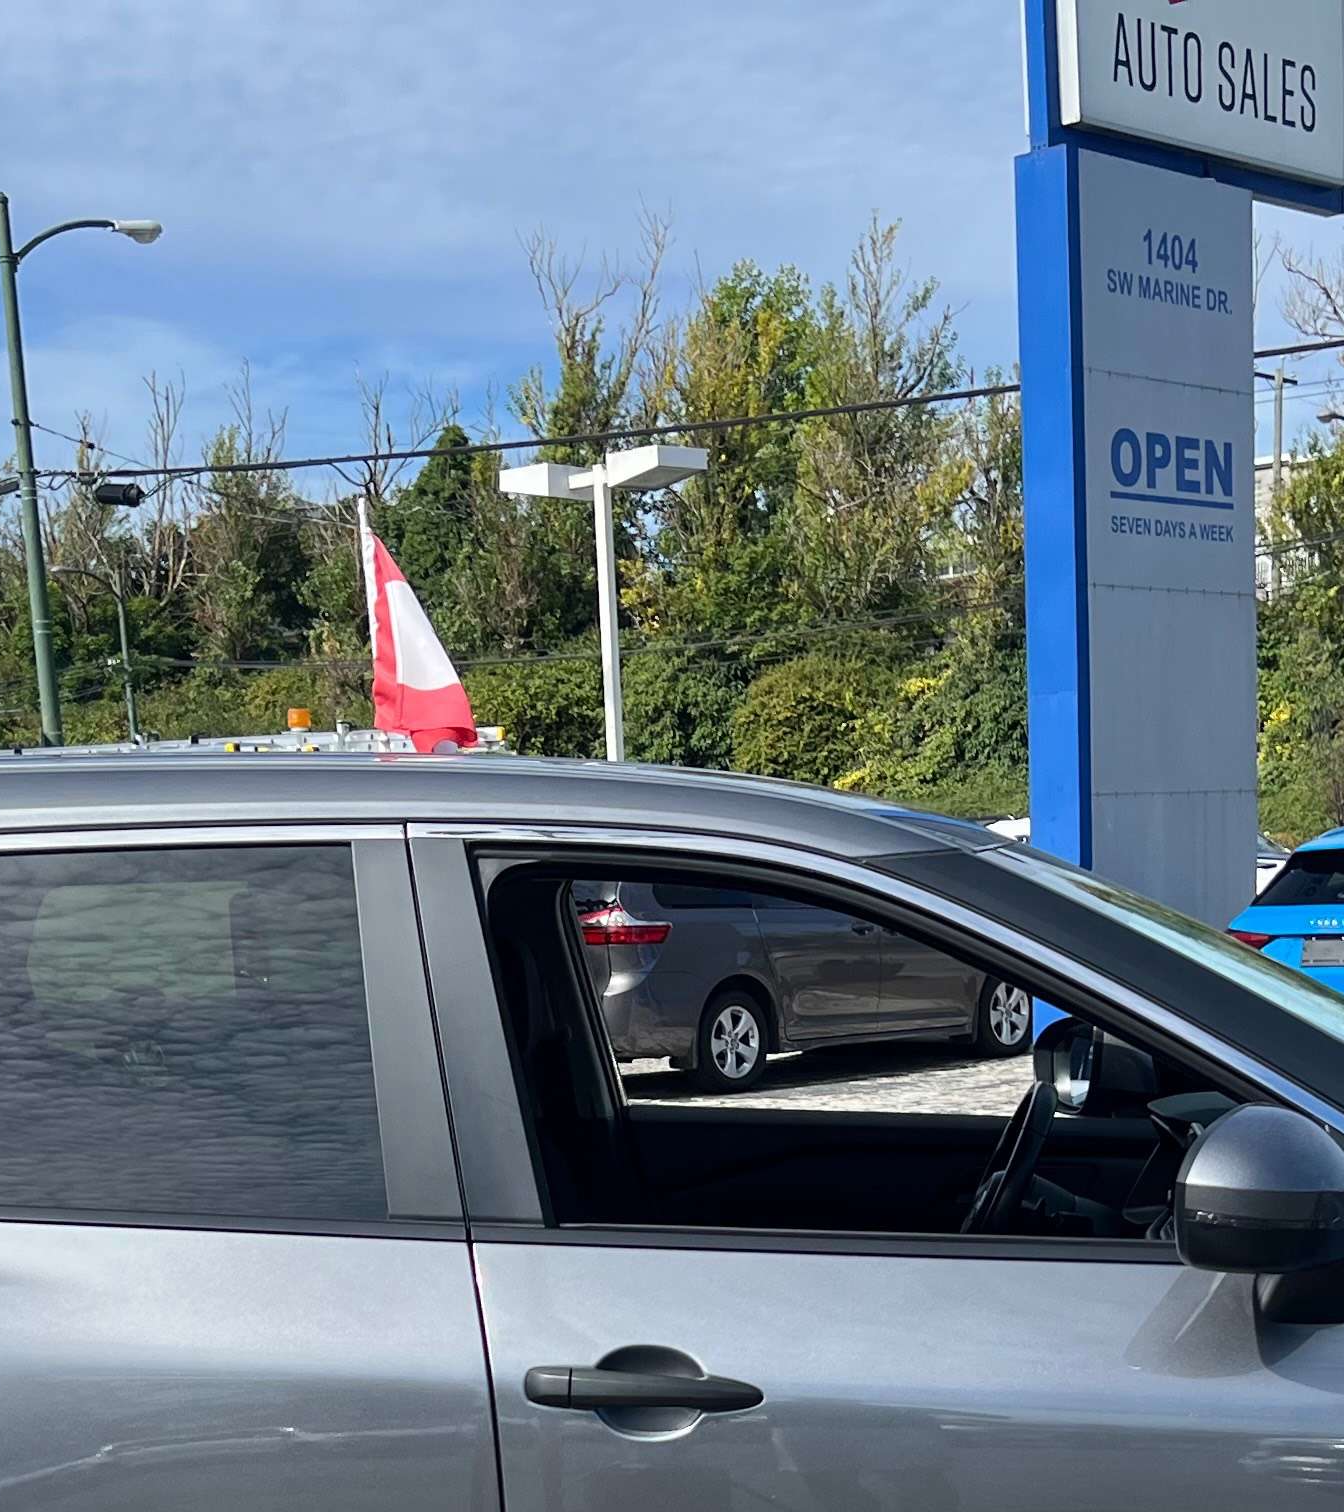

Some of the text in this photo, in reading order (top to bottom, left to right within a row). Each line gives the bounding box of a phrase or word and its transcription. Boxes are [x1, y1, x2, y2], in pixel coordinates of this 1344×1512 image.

[1113, 13, 1316, 132] AUTO SALES
[1143, 228, 1198, 274] 1404
[1107, 268, 1233, 315] SW MARINE DR.
[1110, 427, 1233, 497] OPEN
[1111, 515, 1234, 543] SEVEN DAYS A WEEK
